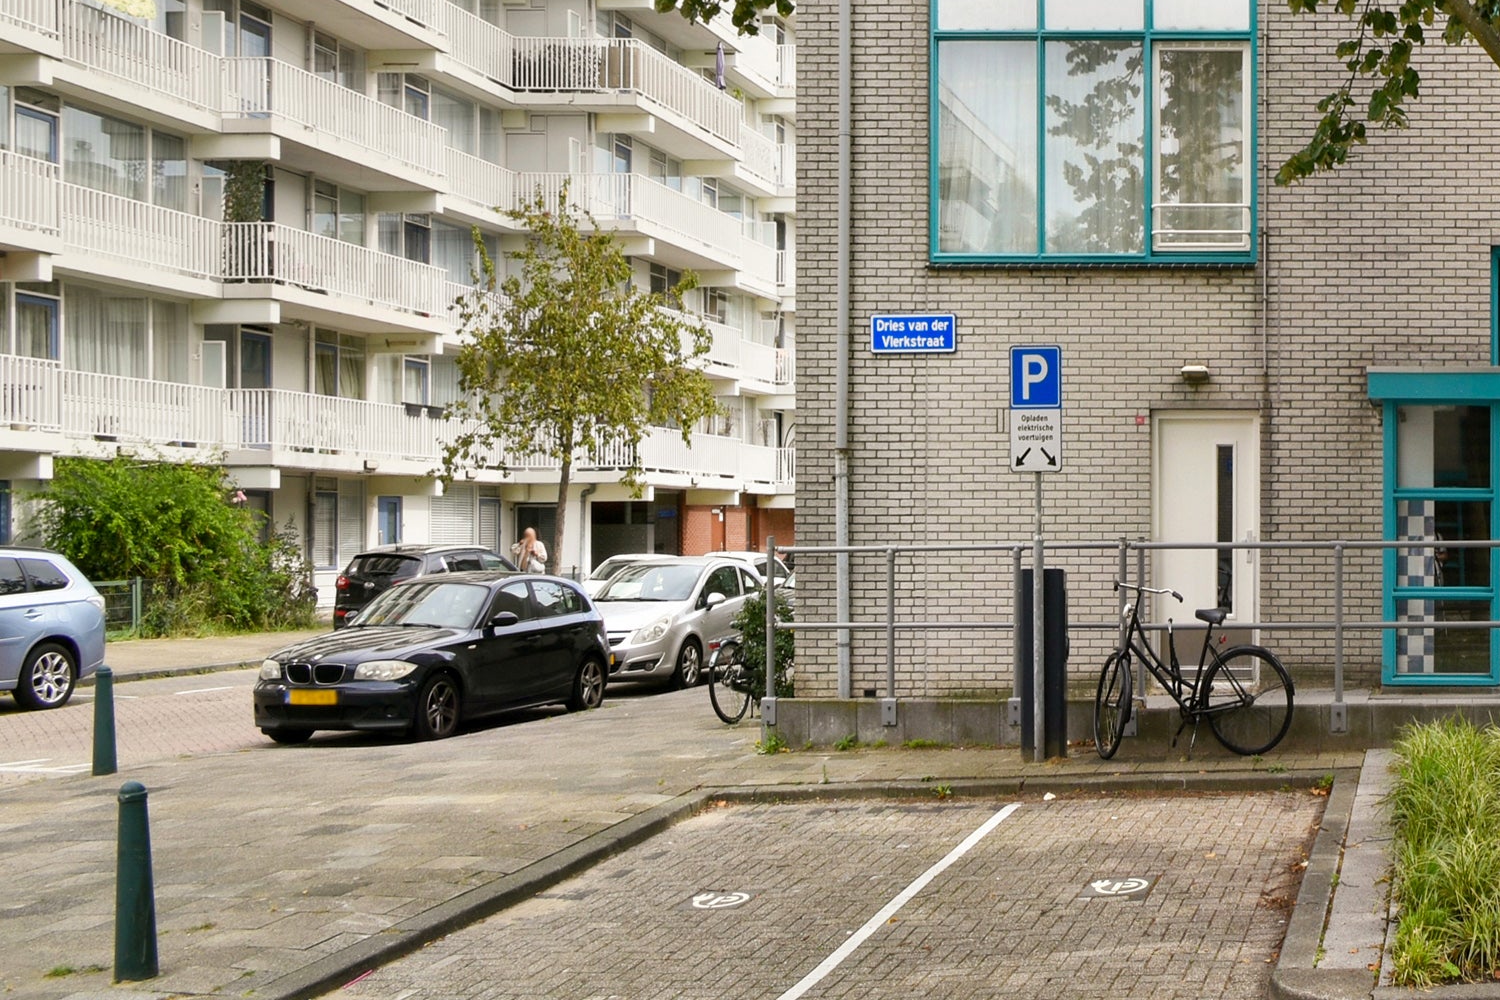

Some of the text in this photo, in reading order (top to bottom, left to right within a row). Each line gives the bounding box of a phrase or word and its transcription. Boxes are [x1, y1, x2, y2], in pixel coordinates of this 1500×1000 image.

[877, 319, 949, 331] Dries van der
[882, 336, 944, 347] Vlerkstraat
[1022, 354, 1048, 400] P
[1021, 414, 1048, 422] Opladen
[1018, 434, 1053, 442] voertuigen
